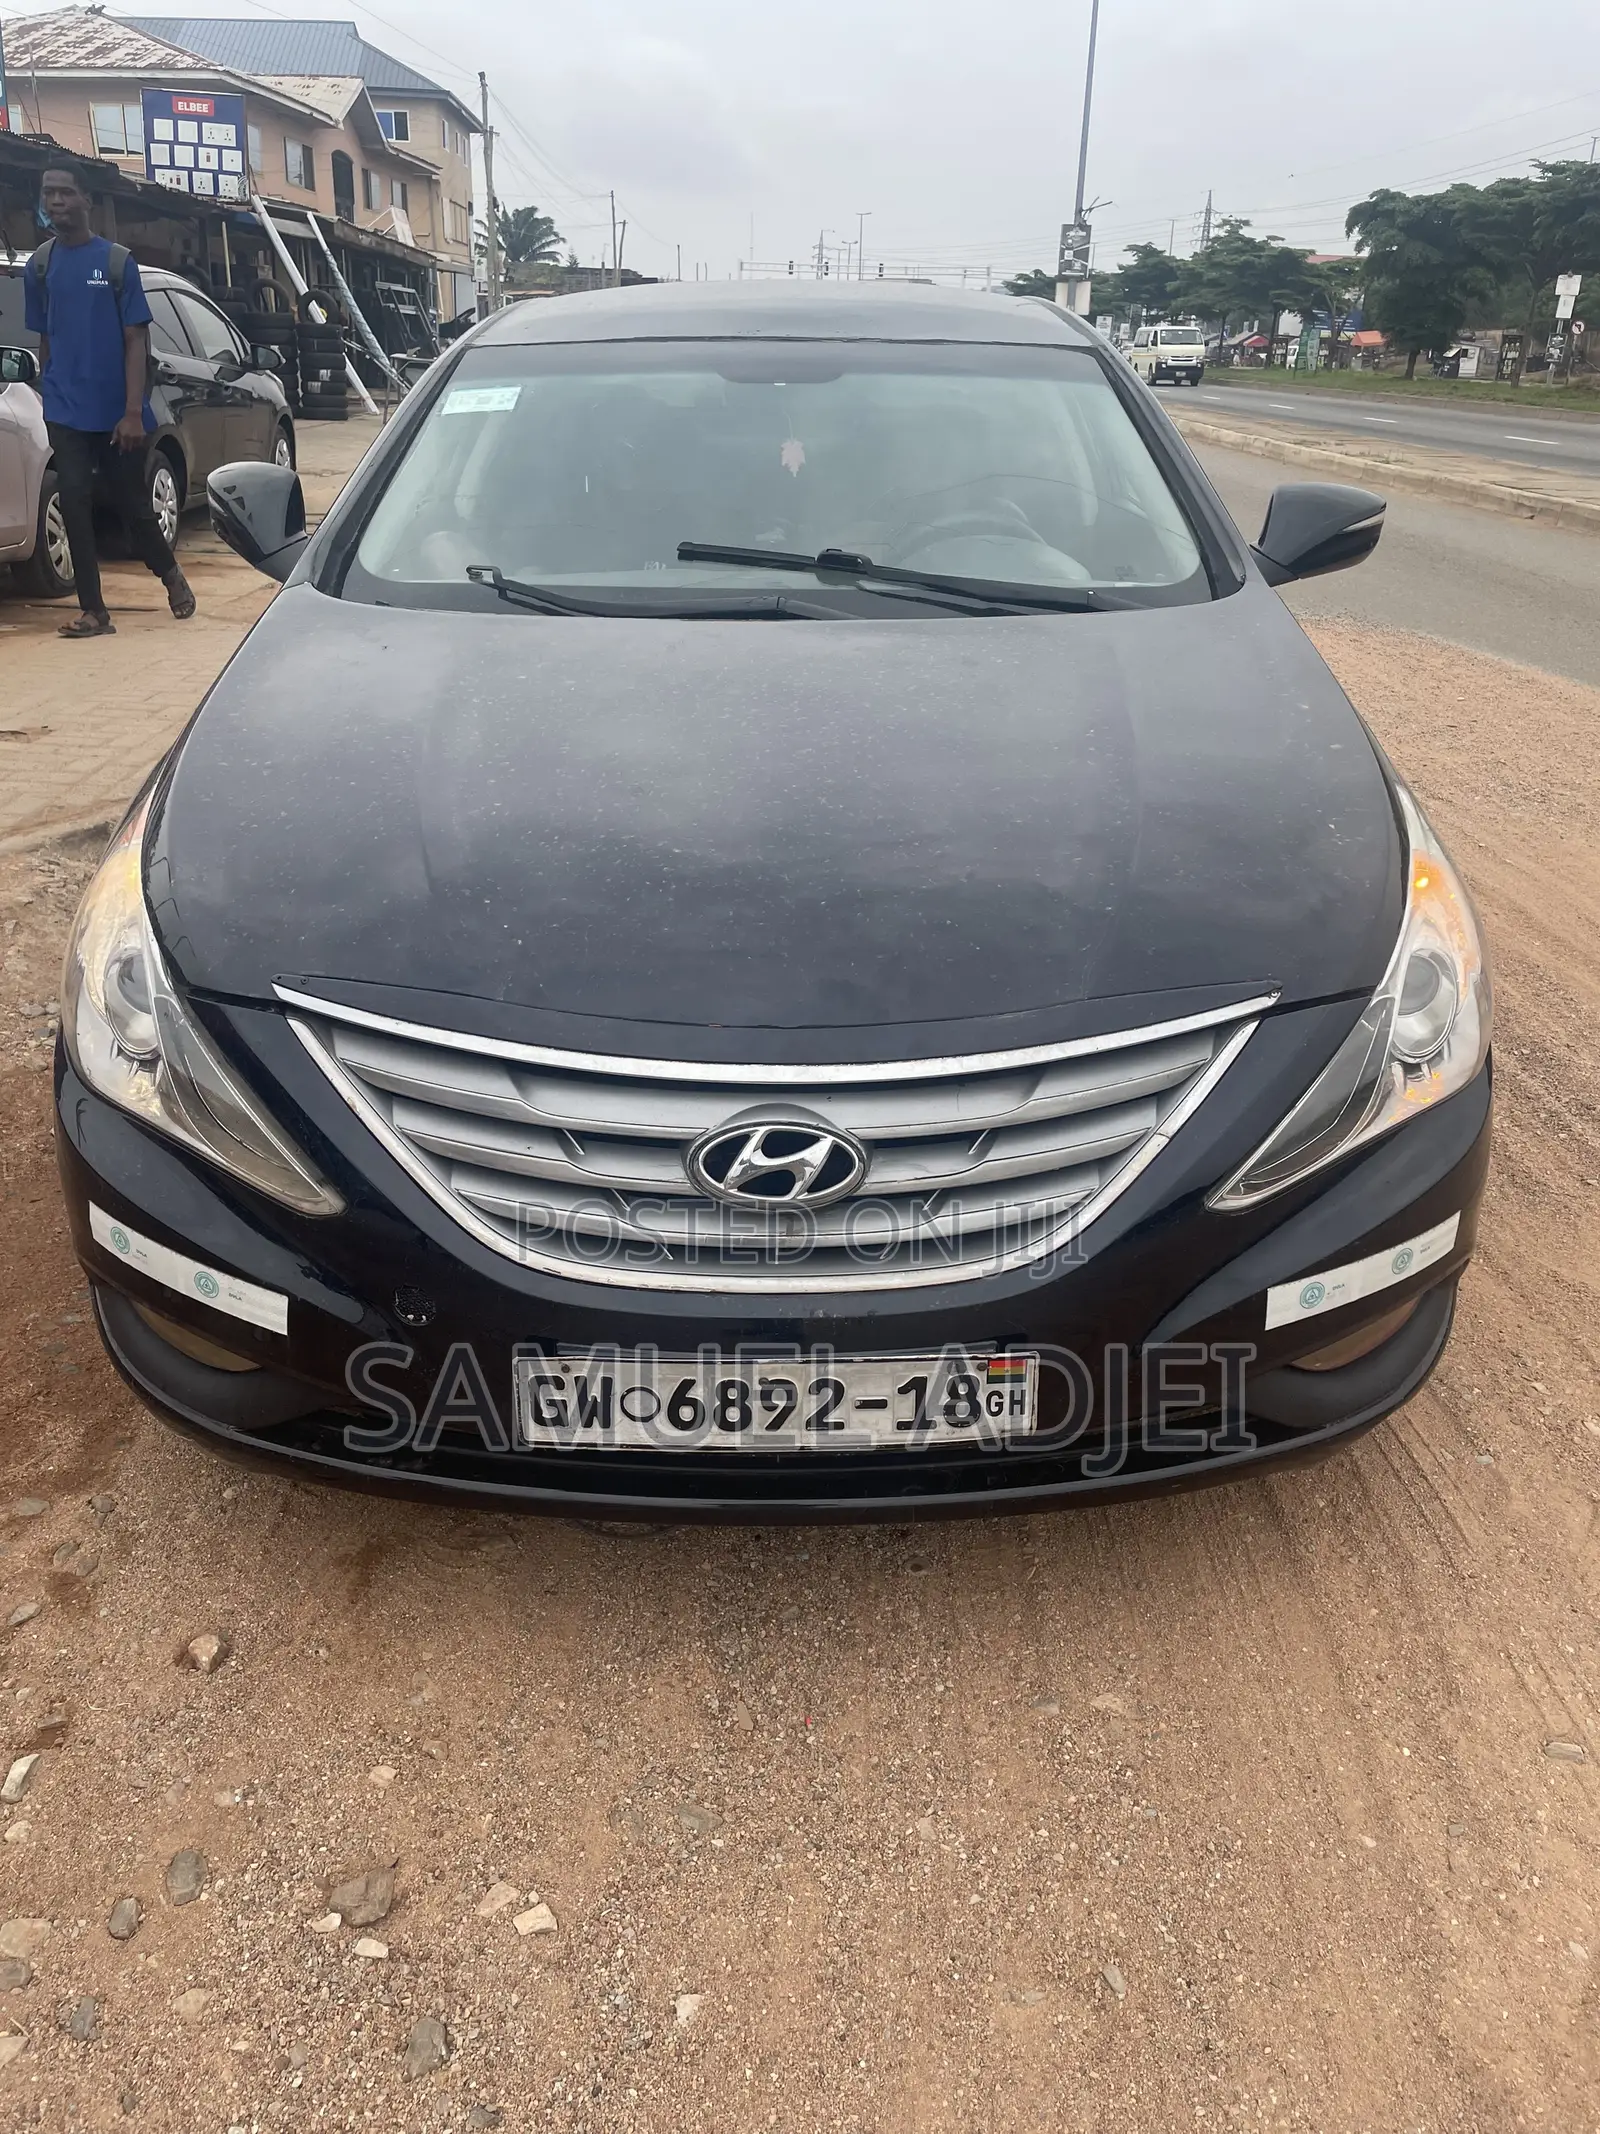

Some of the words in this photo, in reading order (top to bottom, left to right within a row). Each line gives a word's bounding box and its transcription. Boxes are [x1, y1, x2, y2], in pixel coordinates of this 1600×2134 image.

[177, 101, 209, 113] ELBEE
[528, 1374, 615, 1429] GW
[666, 1374, 981, 1433] 6892-18
[985, 1389, 1027, 1418] GH
